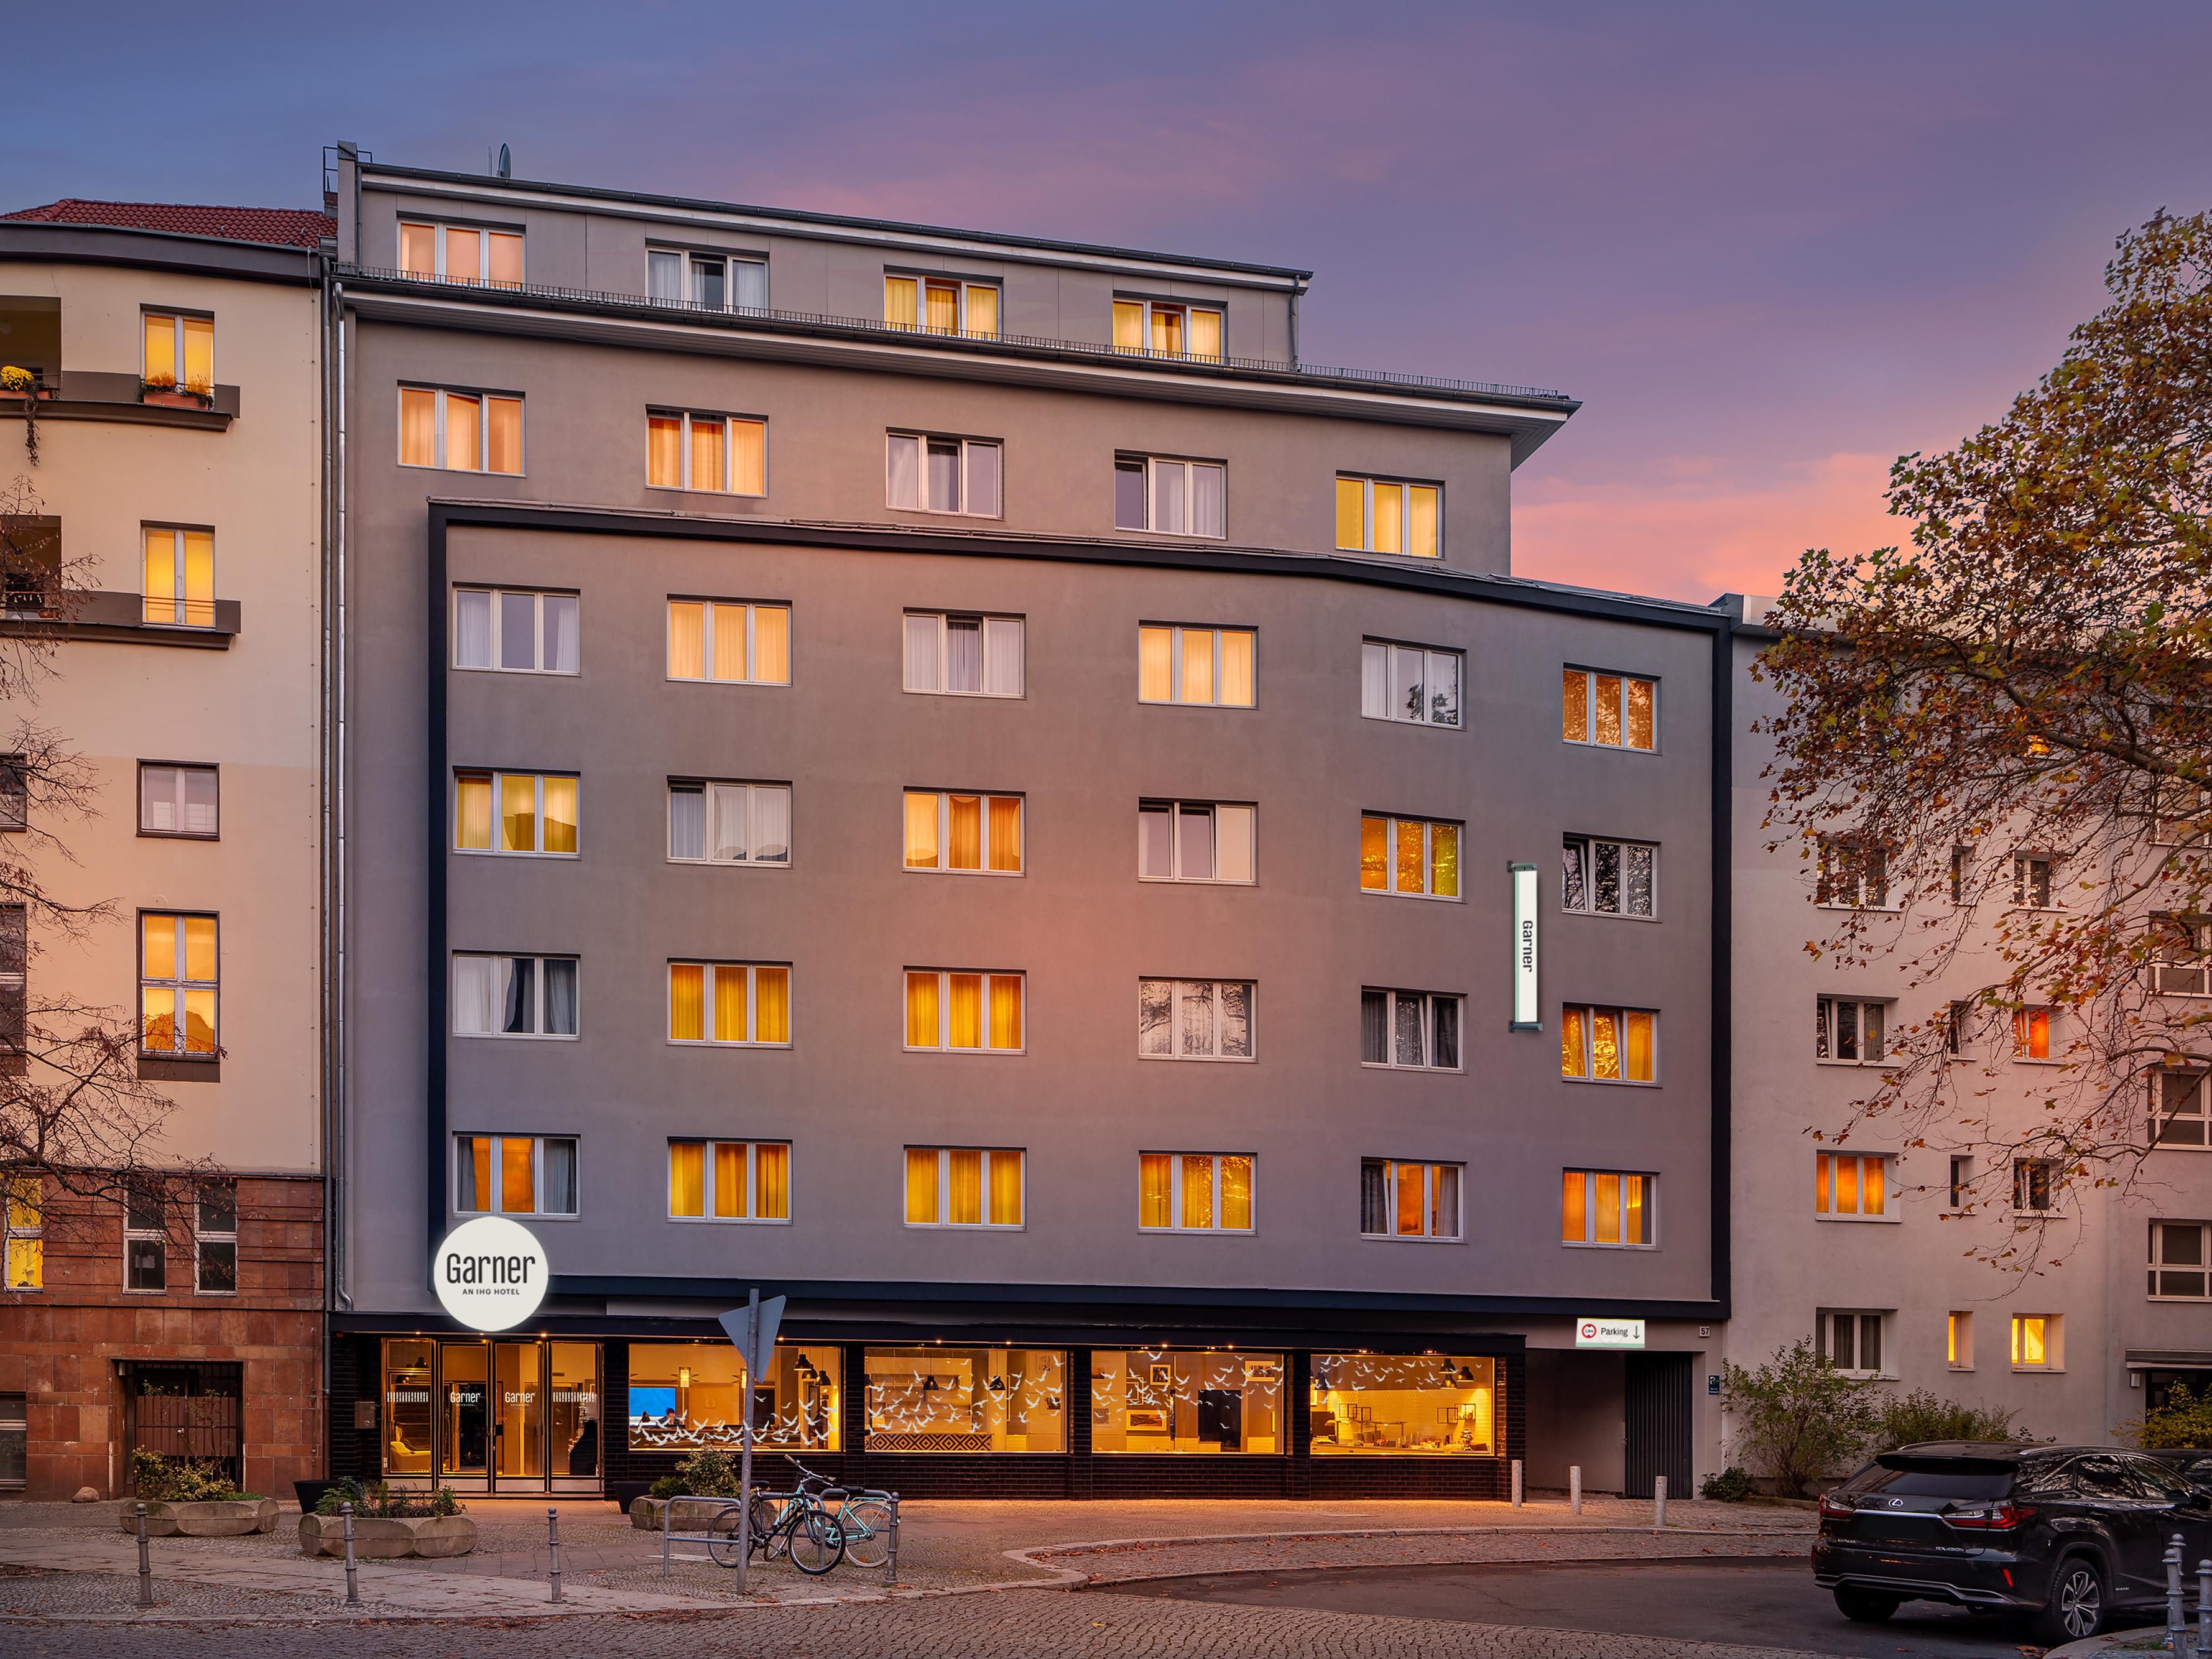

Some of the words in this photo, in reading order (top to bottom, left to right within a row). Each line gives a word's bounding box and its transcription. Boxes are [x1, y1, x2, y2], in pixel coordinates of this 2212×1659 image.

[1522, 920, 1533, 973] Garner
[447, 1253, 536, 1283] Garner
[1601, 1328, 1628, 1338] Parking
[450, 1392, 480, 1403] Garner
[505, 1392, 535, 1403] Garner
